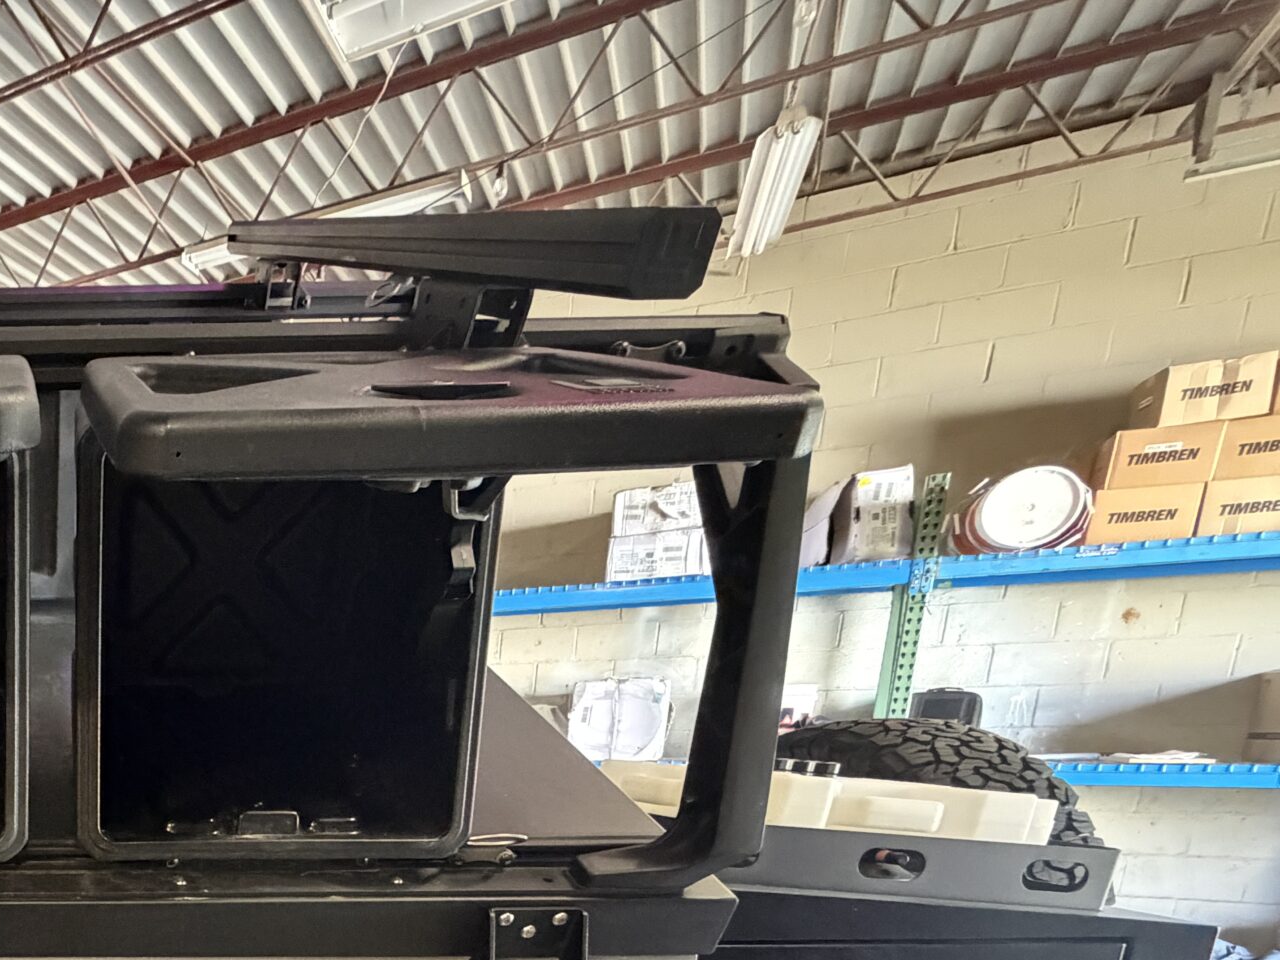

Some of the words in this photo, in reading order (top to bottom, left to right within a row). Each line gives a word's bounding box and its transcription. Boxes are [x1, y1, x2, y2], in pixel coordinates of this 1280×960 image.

[1180, 380, 1253, 400] TIMBREN
[1127, 448, 1200, 466] TIMBREN
[1107, 508, 1178, 524] TIMBREN
